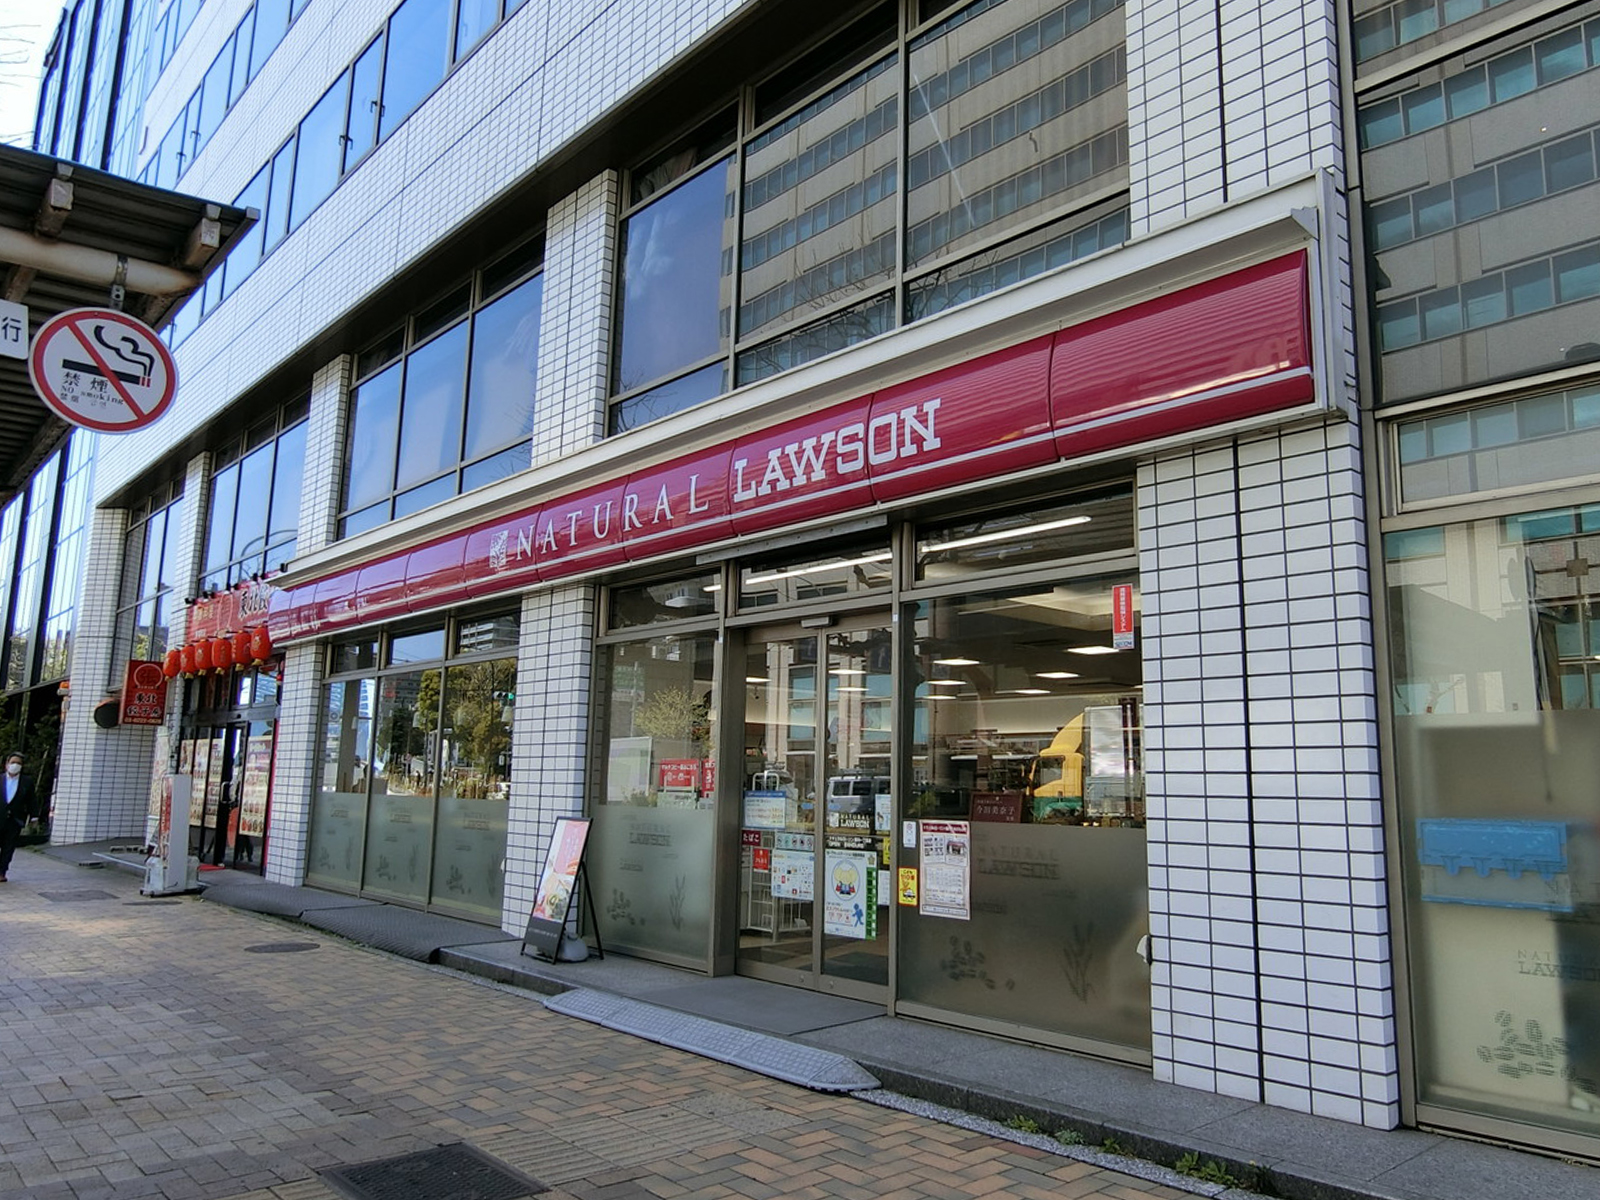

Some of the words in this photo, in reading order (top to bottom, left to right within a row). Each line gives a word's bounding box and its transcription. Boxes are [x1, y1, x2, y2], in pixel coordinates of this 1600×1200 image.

[2, 316, 22, 342] 行
[61, 385, 75, 395] NO
[63, 371, 108, 393] 禁煙
[516, 473, 709, 562] NATURAL
[733, 397, 941, 504] LAWSON
[840, 819, 870, 829] LAWSON
[743, 832, 760, 843] たばこ
